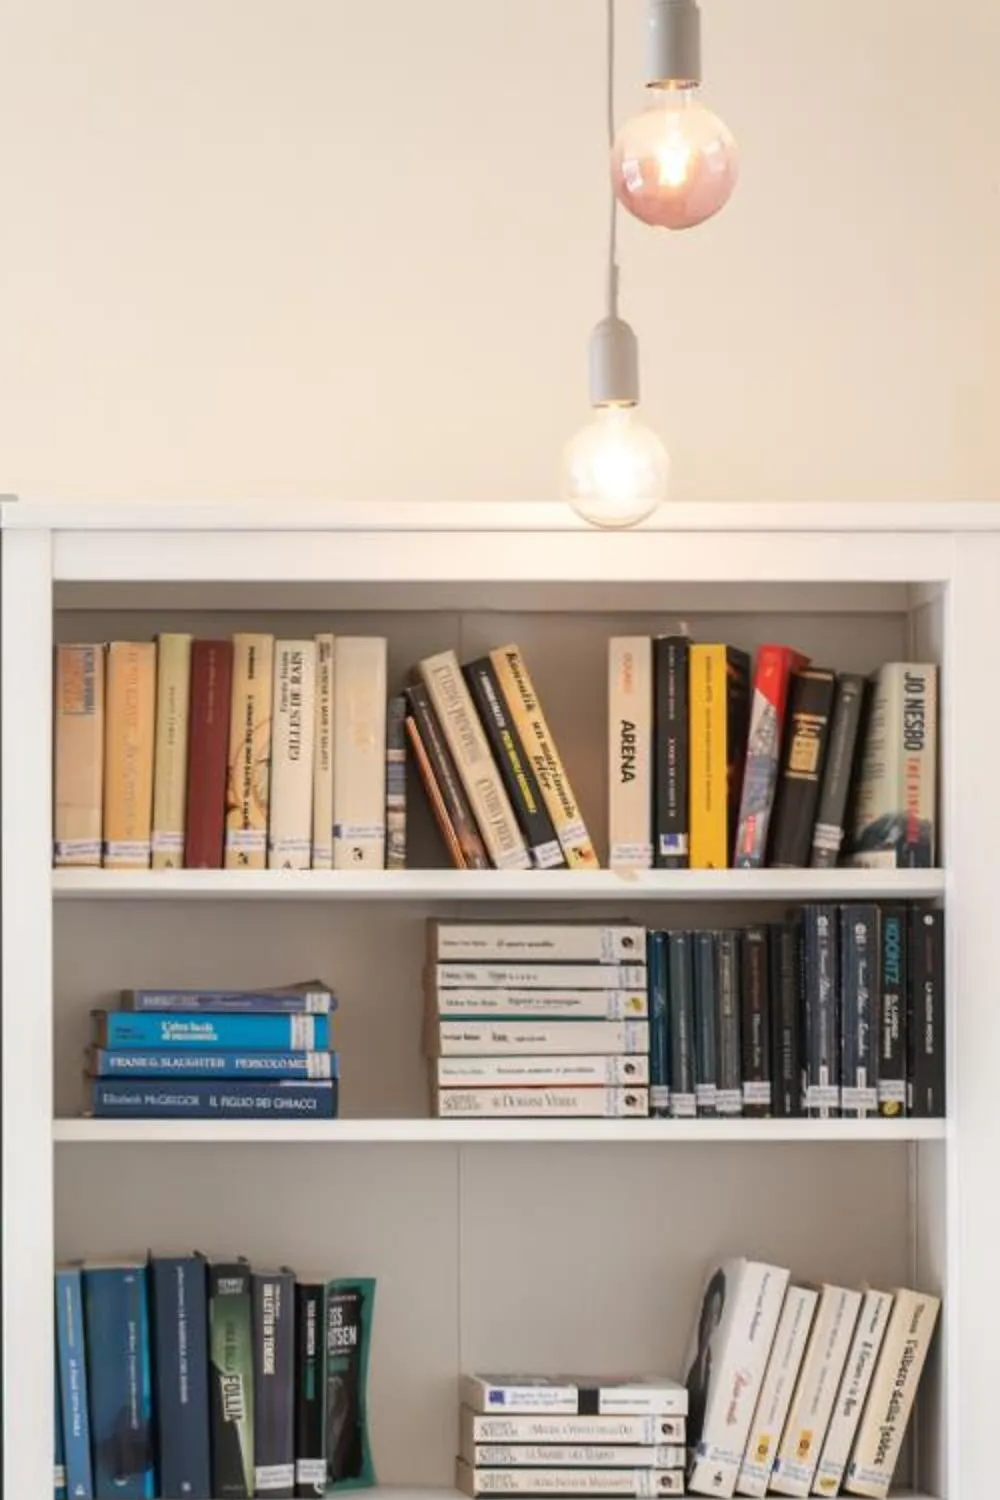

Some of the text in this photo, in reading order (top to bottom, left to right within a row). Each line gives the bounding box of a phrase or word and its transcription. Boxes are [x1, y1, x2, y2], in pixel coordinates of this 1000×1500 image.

[904, 671, 924, 693] JO
[289, 651, 302, 761] GILLES DE RAIS
[620, 719, 636, 784] ARENA
[905, 757, 920, 779] THE
[884, 921, 900, 985] KOONTZ
[220, 1096, 254, 1109] FIGLIO
[222, 1376, 243, 1422] FOLLIA
